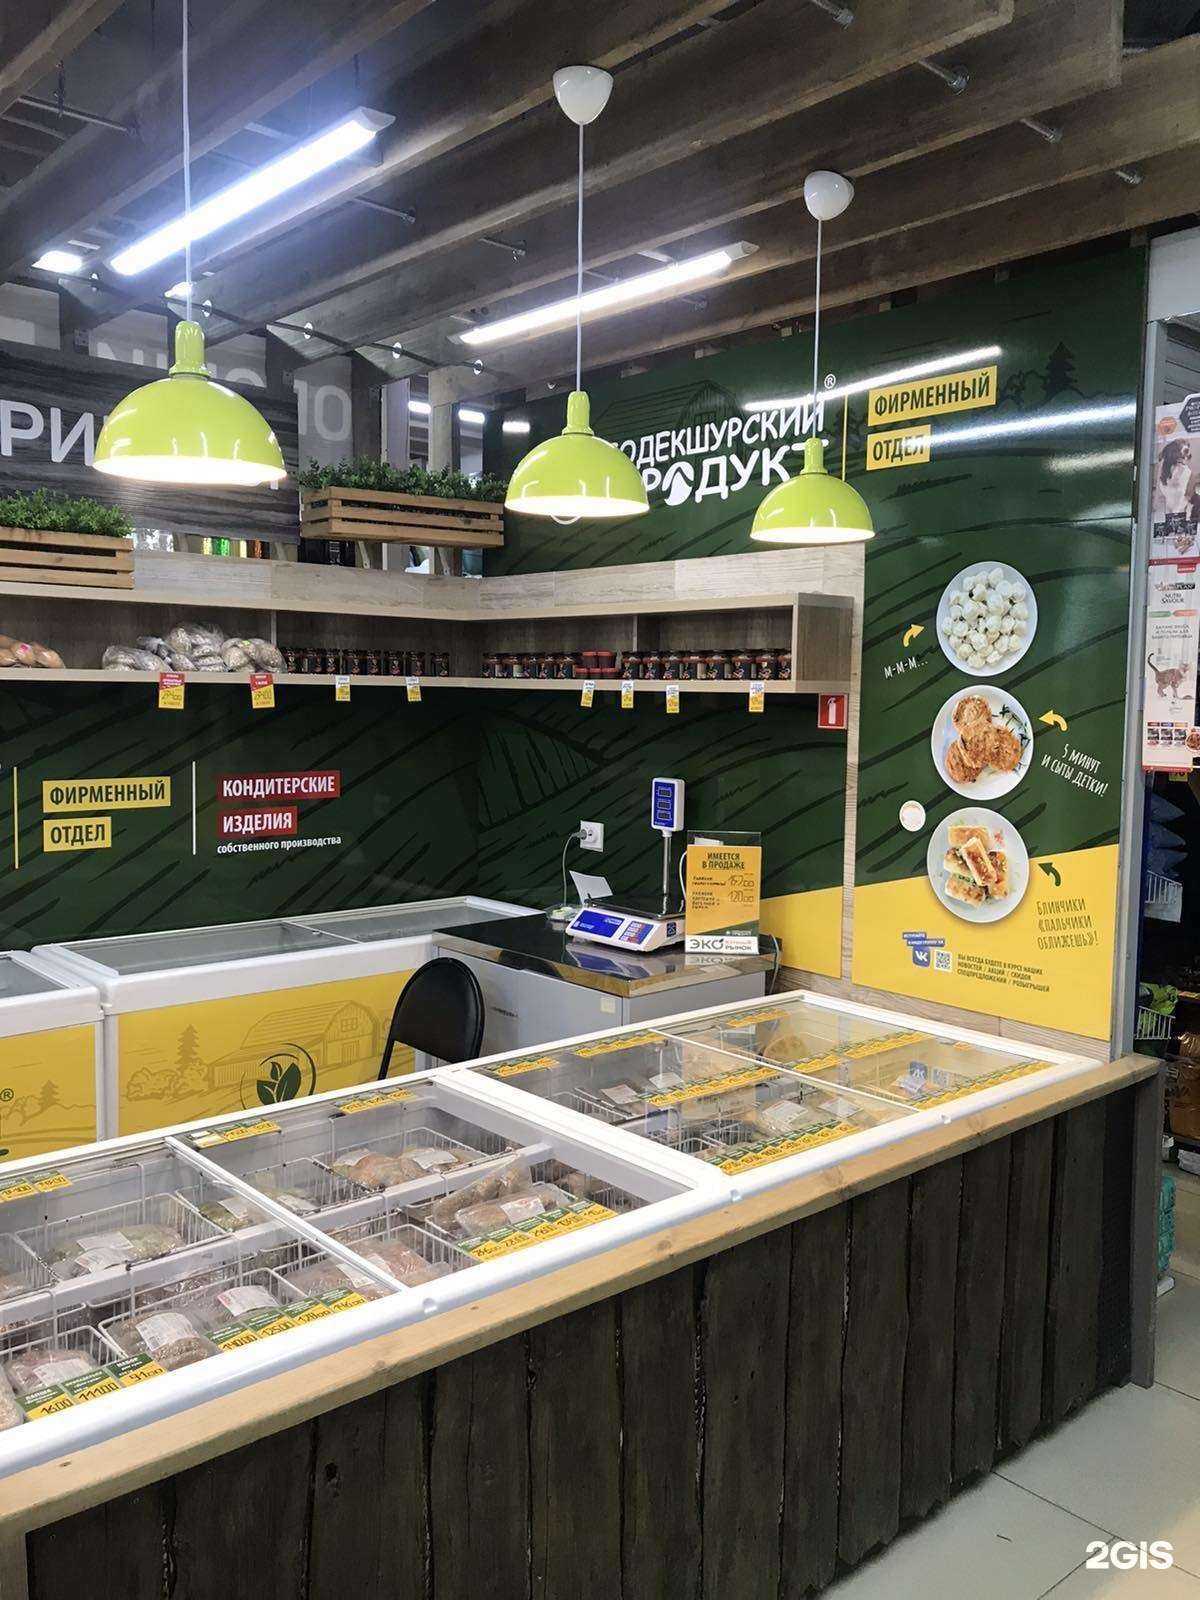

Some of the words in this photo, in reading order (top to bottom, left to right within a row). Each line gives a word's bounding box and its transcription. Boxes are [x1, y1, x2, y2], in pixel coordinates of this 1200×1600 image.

[874, 371, 990, 416] ФИРМЕННЫЙ
[613, 394, 825, 469] ОДЕКШУРСКИЙ
[873, 435, 925, 462] ОТДЕЛ
[1062, 743, 1069, 758] 5
[1068, 749, 1101, 774] МИНУТ
[223, 776, 335, 798] КОНДИТЕРСКИЕ
[1041, 754, 1051, 768] И
[1050, 759, 1075, 780] СЫТЫ
[1072, 771, 1109, 797] ДЕТКИ!
[50, 779, 165, 805] ФИРМЕННЫЙ
[50, 824, 106, 846] ОТДЕЛ
[223, 812, 292, 835] ИЗДЕЛИЯ
[217, 841, 279, 854] собственного
[280, 836, 342, 850] производства
[707, 852, 740, 860] ИМЕЕТСЯ
[702, 861, 708, 869] В
[708, 861, 745, 870] ПРОДАЖЕ
[1036, 898, 1086, 915] БЛИНЧИКИ
